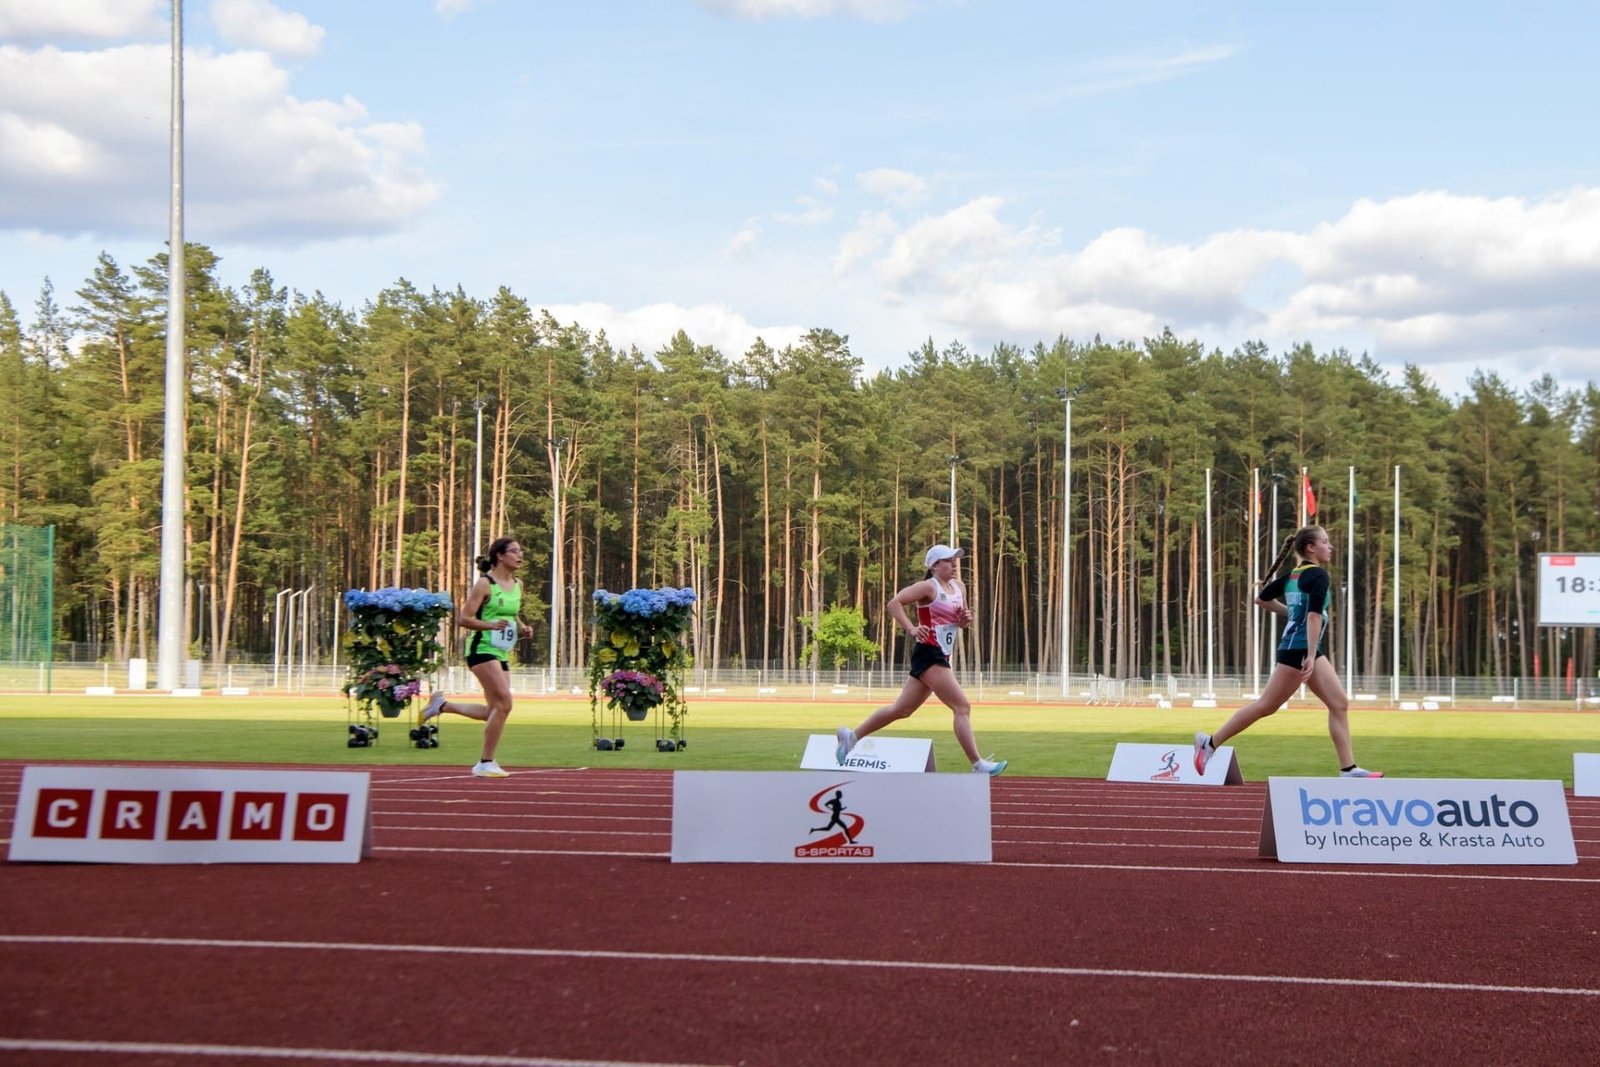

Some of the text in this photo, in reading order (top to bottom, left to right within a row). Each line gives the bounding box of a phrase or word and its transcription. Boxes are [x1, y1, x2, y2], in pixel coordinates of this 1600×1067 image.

[1555, 576, 1600, 593] 18:
[499, 629, 514, 641] 19
[946, 632, 953, 645] 6
[47, 798, 336, 832] CRAMO
[1299, 788, 1539, 828] bravoauto
[1304, 830, 1545, 851] by Inchcape & Krasta Auto
[796, 847, 872, 857] S-SPORTAS
